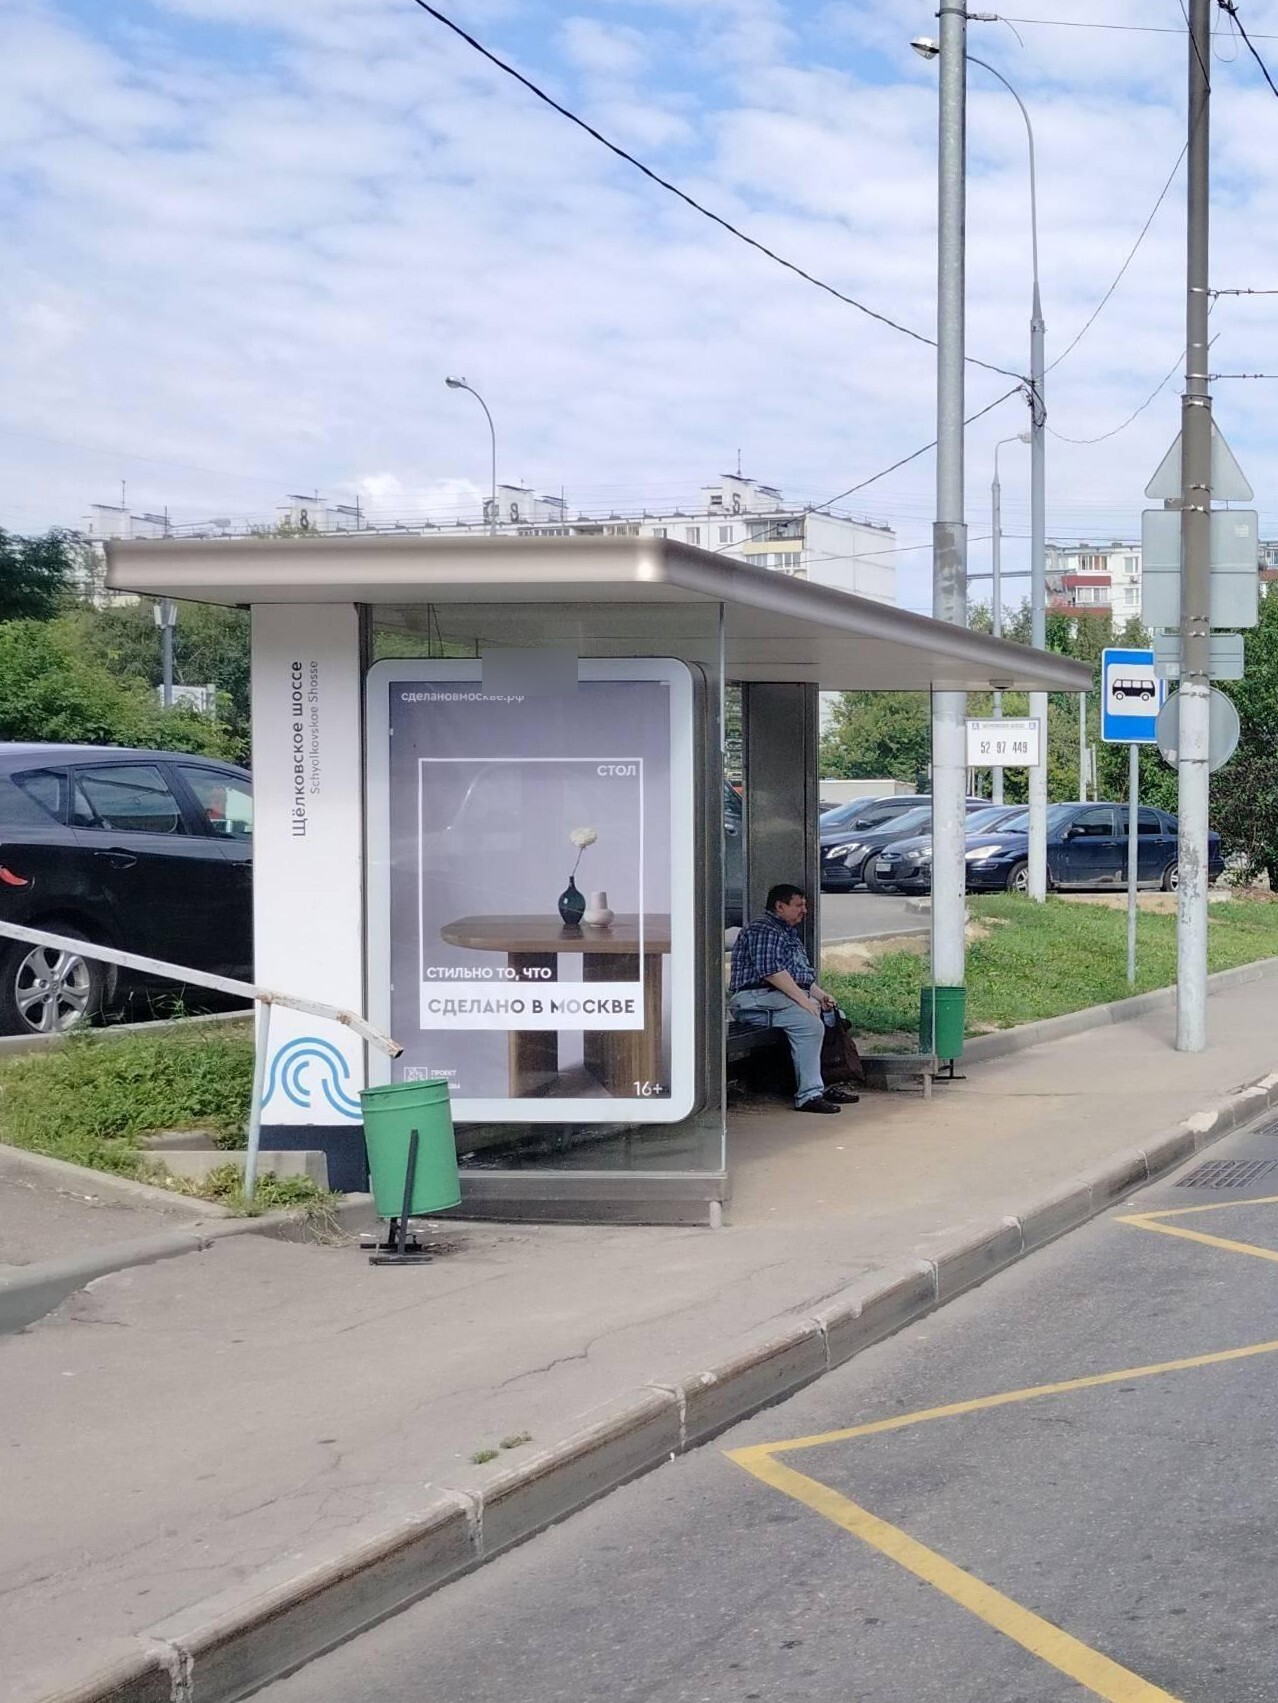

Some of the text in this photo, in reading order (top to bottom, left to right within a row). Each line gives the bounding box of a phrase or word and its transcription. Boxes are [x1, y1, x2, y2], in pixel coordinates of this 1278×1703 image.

[308, 660, 322, 794] Schyolkovskoe Shosse
[292, 661, 308, 837] Щёлковское шоссе
[980, 741, 991, 754] 52
[1012, 741, 1028, 754] 449
[597, 765, 637, 777] СТОЛ
[426, 966, 552, 981] СТИЛЬНО ТО, ЧТО
[427, 999, 635, 1016] СДЕЛАНО В МОСКВЕ
[633, 1080, 663, 1097] 16+
